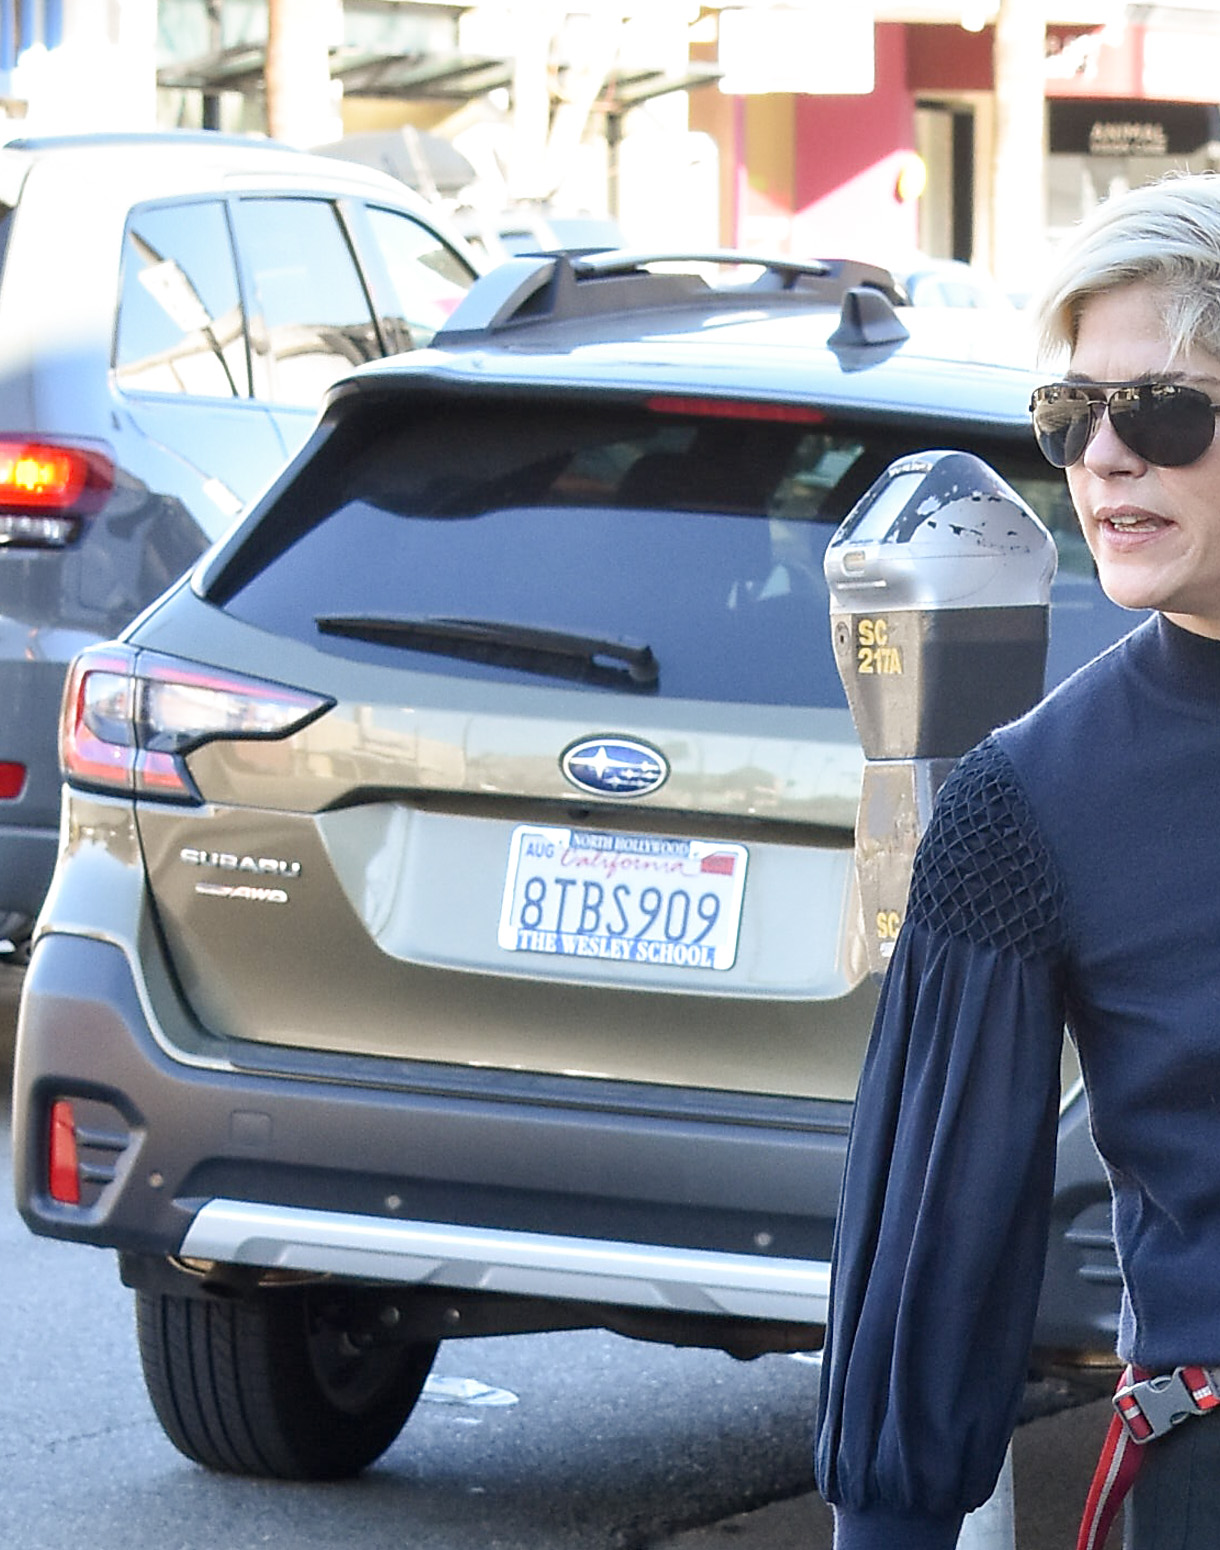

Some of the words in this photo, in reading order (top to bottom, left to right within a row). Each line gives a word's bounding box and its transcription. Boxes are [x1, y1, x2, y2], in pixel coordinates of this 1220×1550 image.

[858, 618, 888, 646] SC
[526, 842, 555, 859] AUG
[572, 834, 614, 852] NORTH
[614, 836, 690, 857] HOLLYWOOD
[180, 847, 302, 877] SUBARU
[560, 847, 697, 879] California
[519, 876, 721, 945] 8TBS909
[876, 911, 900, 938] SC
[519, 929, 557, 951] THE
[557, 931, 635, 960] WESLEY
[635, 943, 713, 968] SCHOOL
